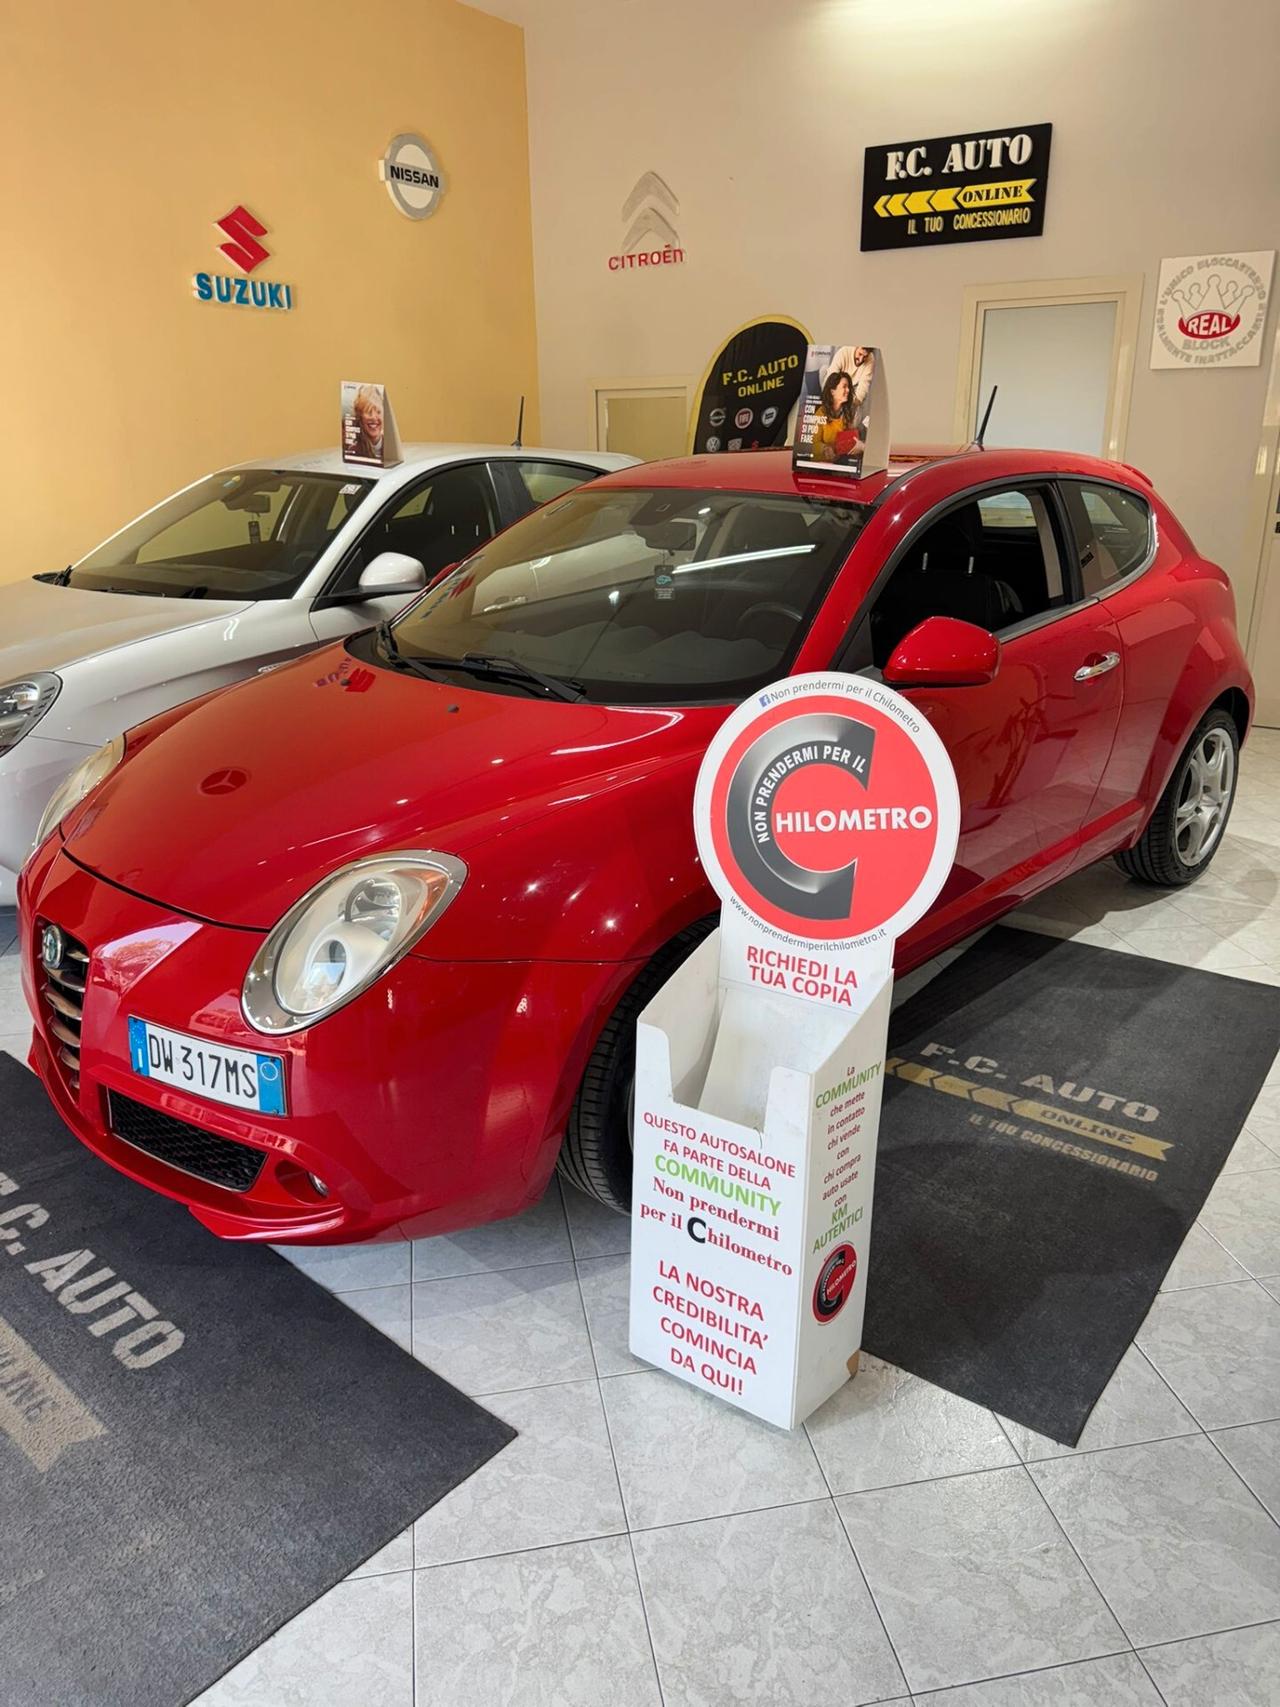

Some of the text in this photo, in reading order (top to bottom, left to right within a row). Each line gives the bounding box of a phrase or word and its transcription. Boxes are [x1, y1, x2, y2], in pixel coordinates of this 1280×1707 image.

[390, 165, 439, 188] NISSAN
[885, 134, 1033, 181] F.C. AUTO
[962, 185, 1023, 203] ONLINE
[907, 207, 1031, 235] IL TUO CONCESSIONARIO
[193, 272, 292, 310] SUZUKI
[1182, 336, 1231, 350] BLOCK
[1187, 314, 1232, 336] REAL
[722, 354, 799, 386] F.C. AUTO
[738, 376, 785, 397] ONLINE
[803, 414, 828, 426] COMPASS
[769, 680, 921, 734] Non prendermi per il Chilometro
[754, 745, 867, 843] NON PRENDERMI PER IL
[729, 896, 888, 951] www.nonprendermiperilchilometro.it
[746, 945, 858, 988] RICHIEDI LA
[748, 964, 852, 1007] TUA COPIA
[148, 1033, 174, 1075] DW
[847, 1066, 855, 1076] La
[815, 1061, 881, 1108] COMMUNITY
[920, 1042, 1160, 1123] F.C. AUTO
[827, 1107, 866, 1135] in contatto
[830, 1092, 865, 1117] che mette
[643, 1111, 796, 1178] QUESTO AUTOSALONE
[827, 1124, 861, 1150] chi vende
[968, 1112, 1160, 1183] IL TUO CONCESSIONARIO
[1039, 1109, 1138, 1145] ONLINE
[663, 1139, 772, 1191] FA PARTE DELLA
[823, 1153, 862, 1184] chi compra
[836, 1147, 850, 1160] con
[655, 1154, 782, 1217] COMMUNITY
[822, 1170, 859, 1201] auto usate
[834, 1194, 847, 1208] con
[653, 1176, 780, 1242] Non prendermi
[812, 1206, 864, 1254] AUTENTICI
[831, 1203, 848, 1225] KM
[640, 1203, 793, 1276] per il Chilometro
[24, 1249, 186, 1370] AUTO
[658, 1259, 765, 1322] LA NOSTRA
[660, 1316, 757, 1375] COMINCIA
[670, 1347, 743, 1396] DA QUI!
